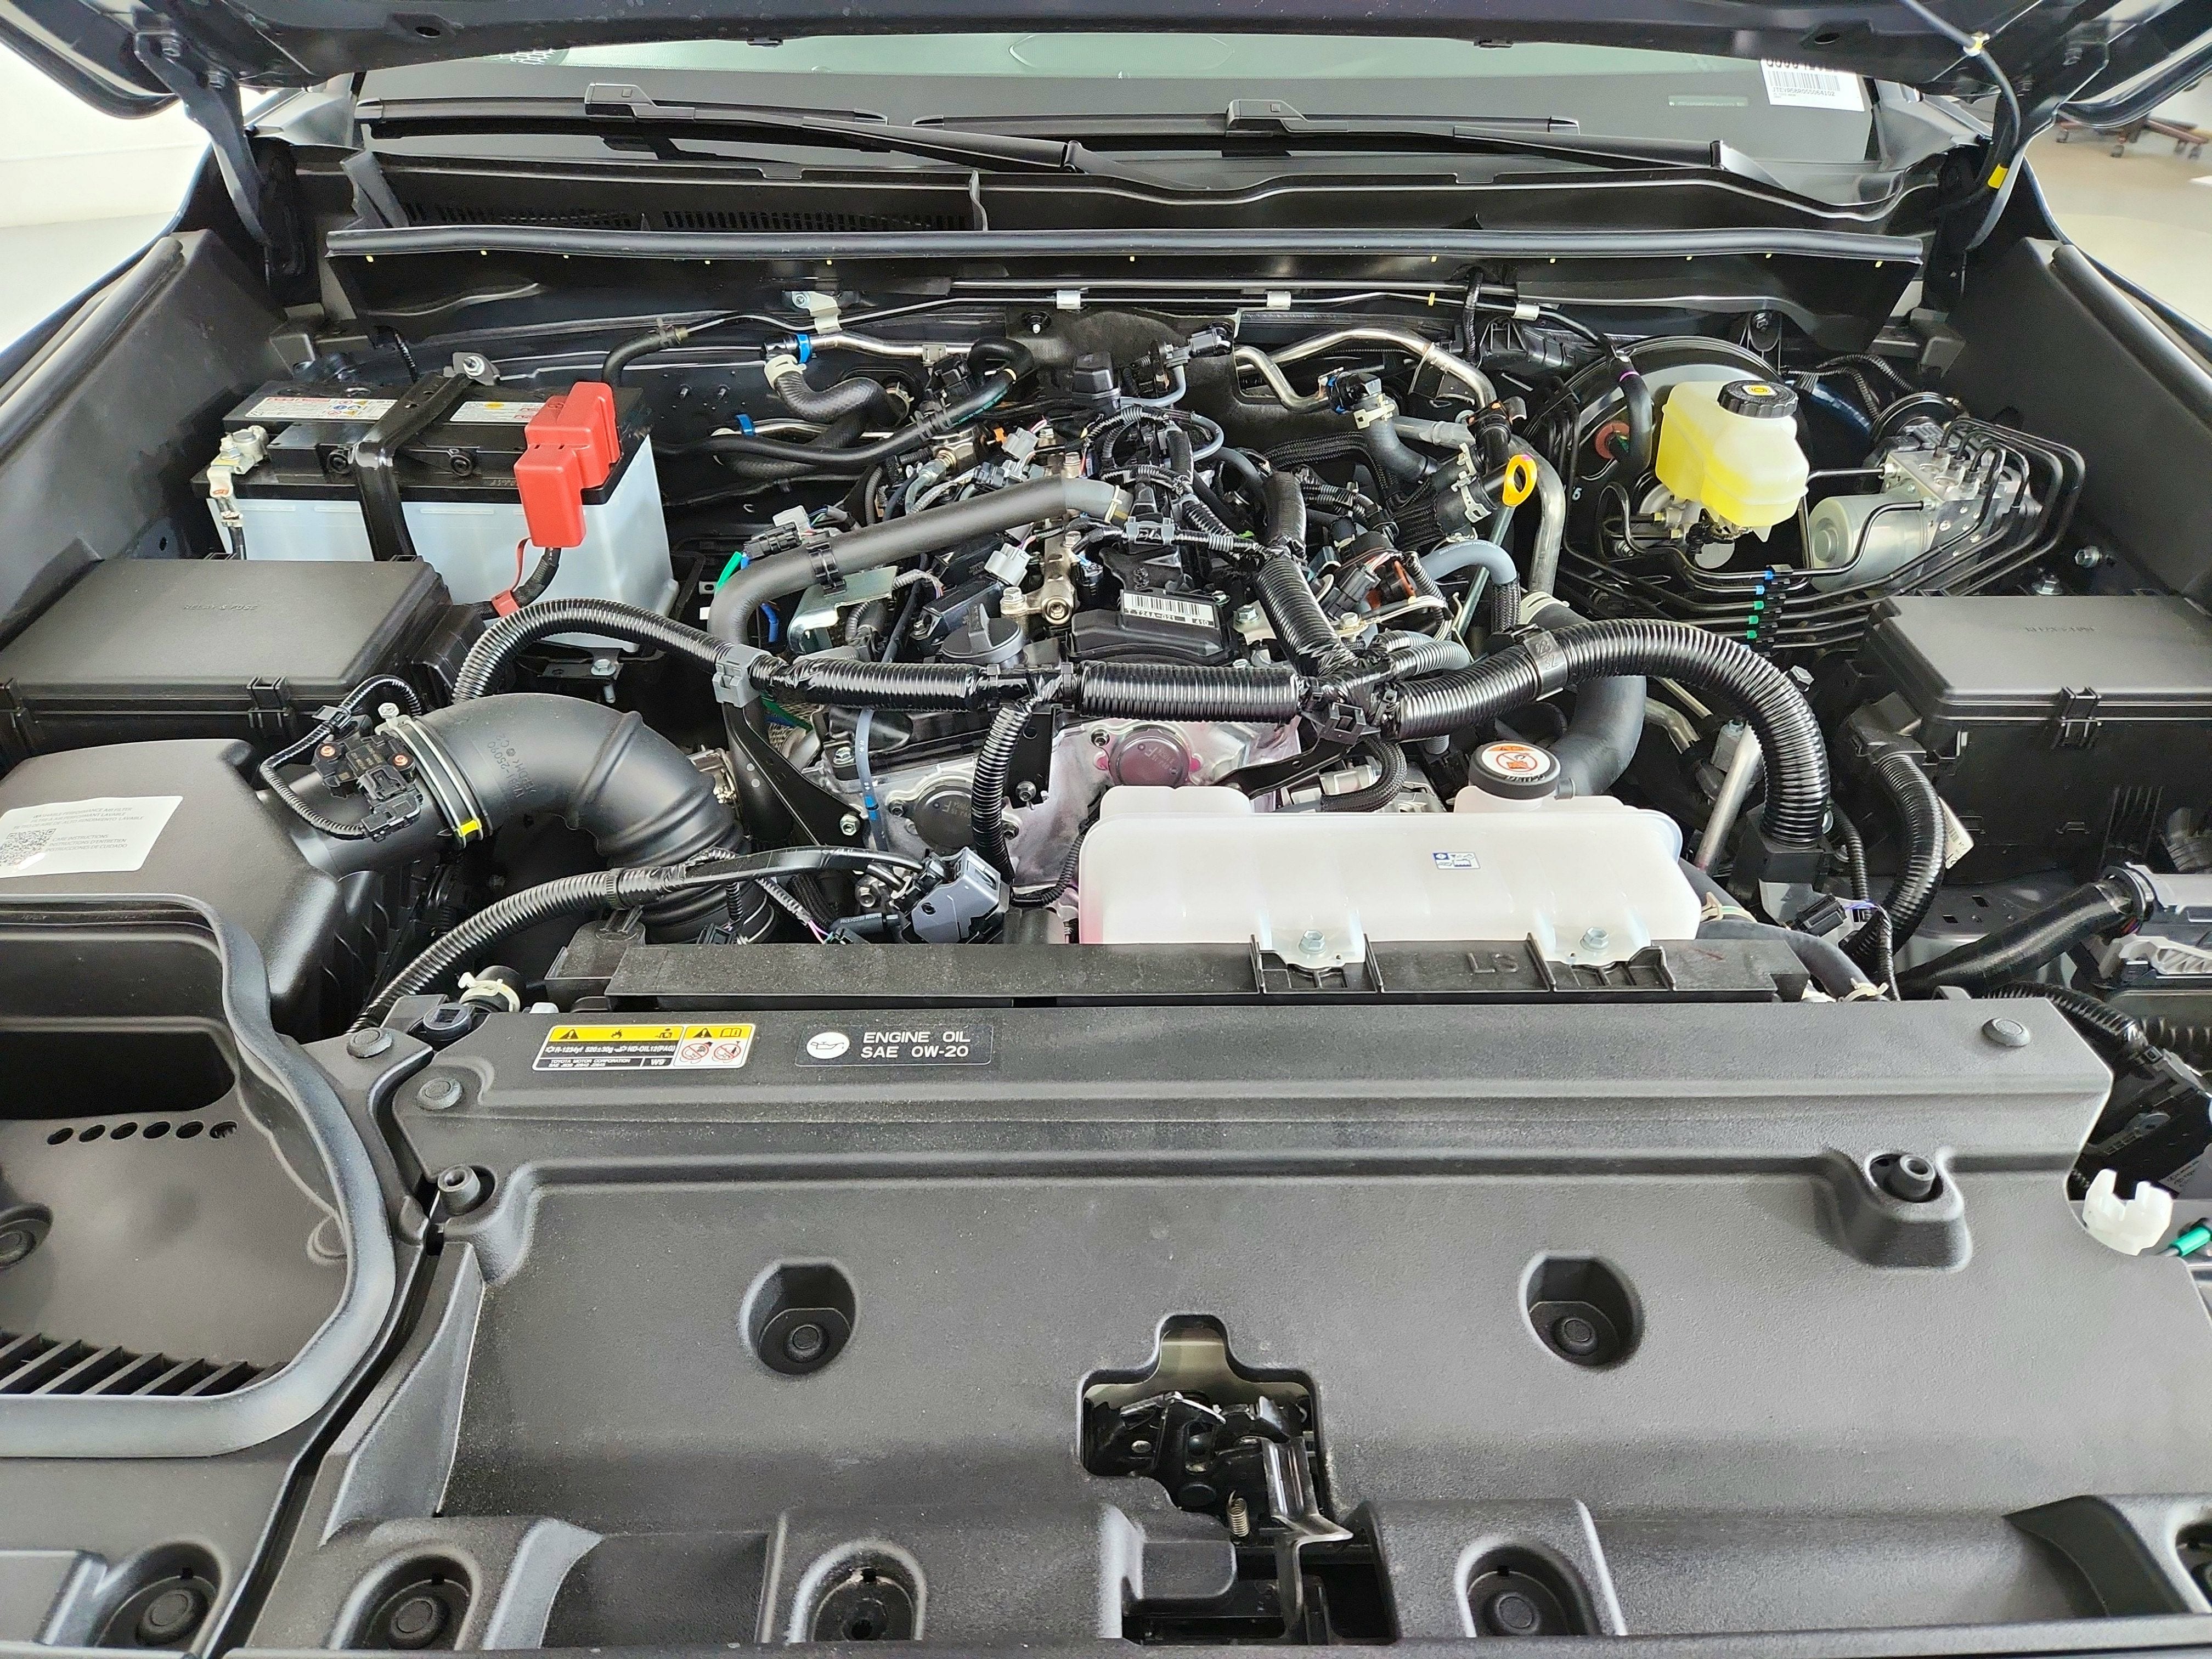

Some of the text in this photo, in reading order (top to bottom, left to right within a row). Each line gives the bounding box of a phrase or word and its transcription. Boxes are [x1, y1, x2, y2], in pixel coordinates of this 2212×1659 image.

[1136, 610, 1175, 620] T24A-G21
[862, 1031, 970, 1043] ENGINE OIL
[860, 1045, 969, 1058] SAE 0W-20
